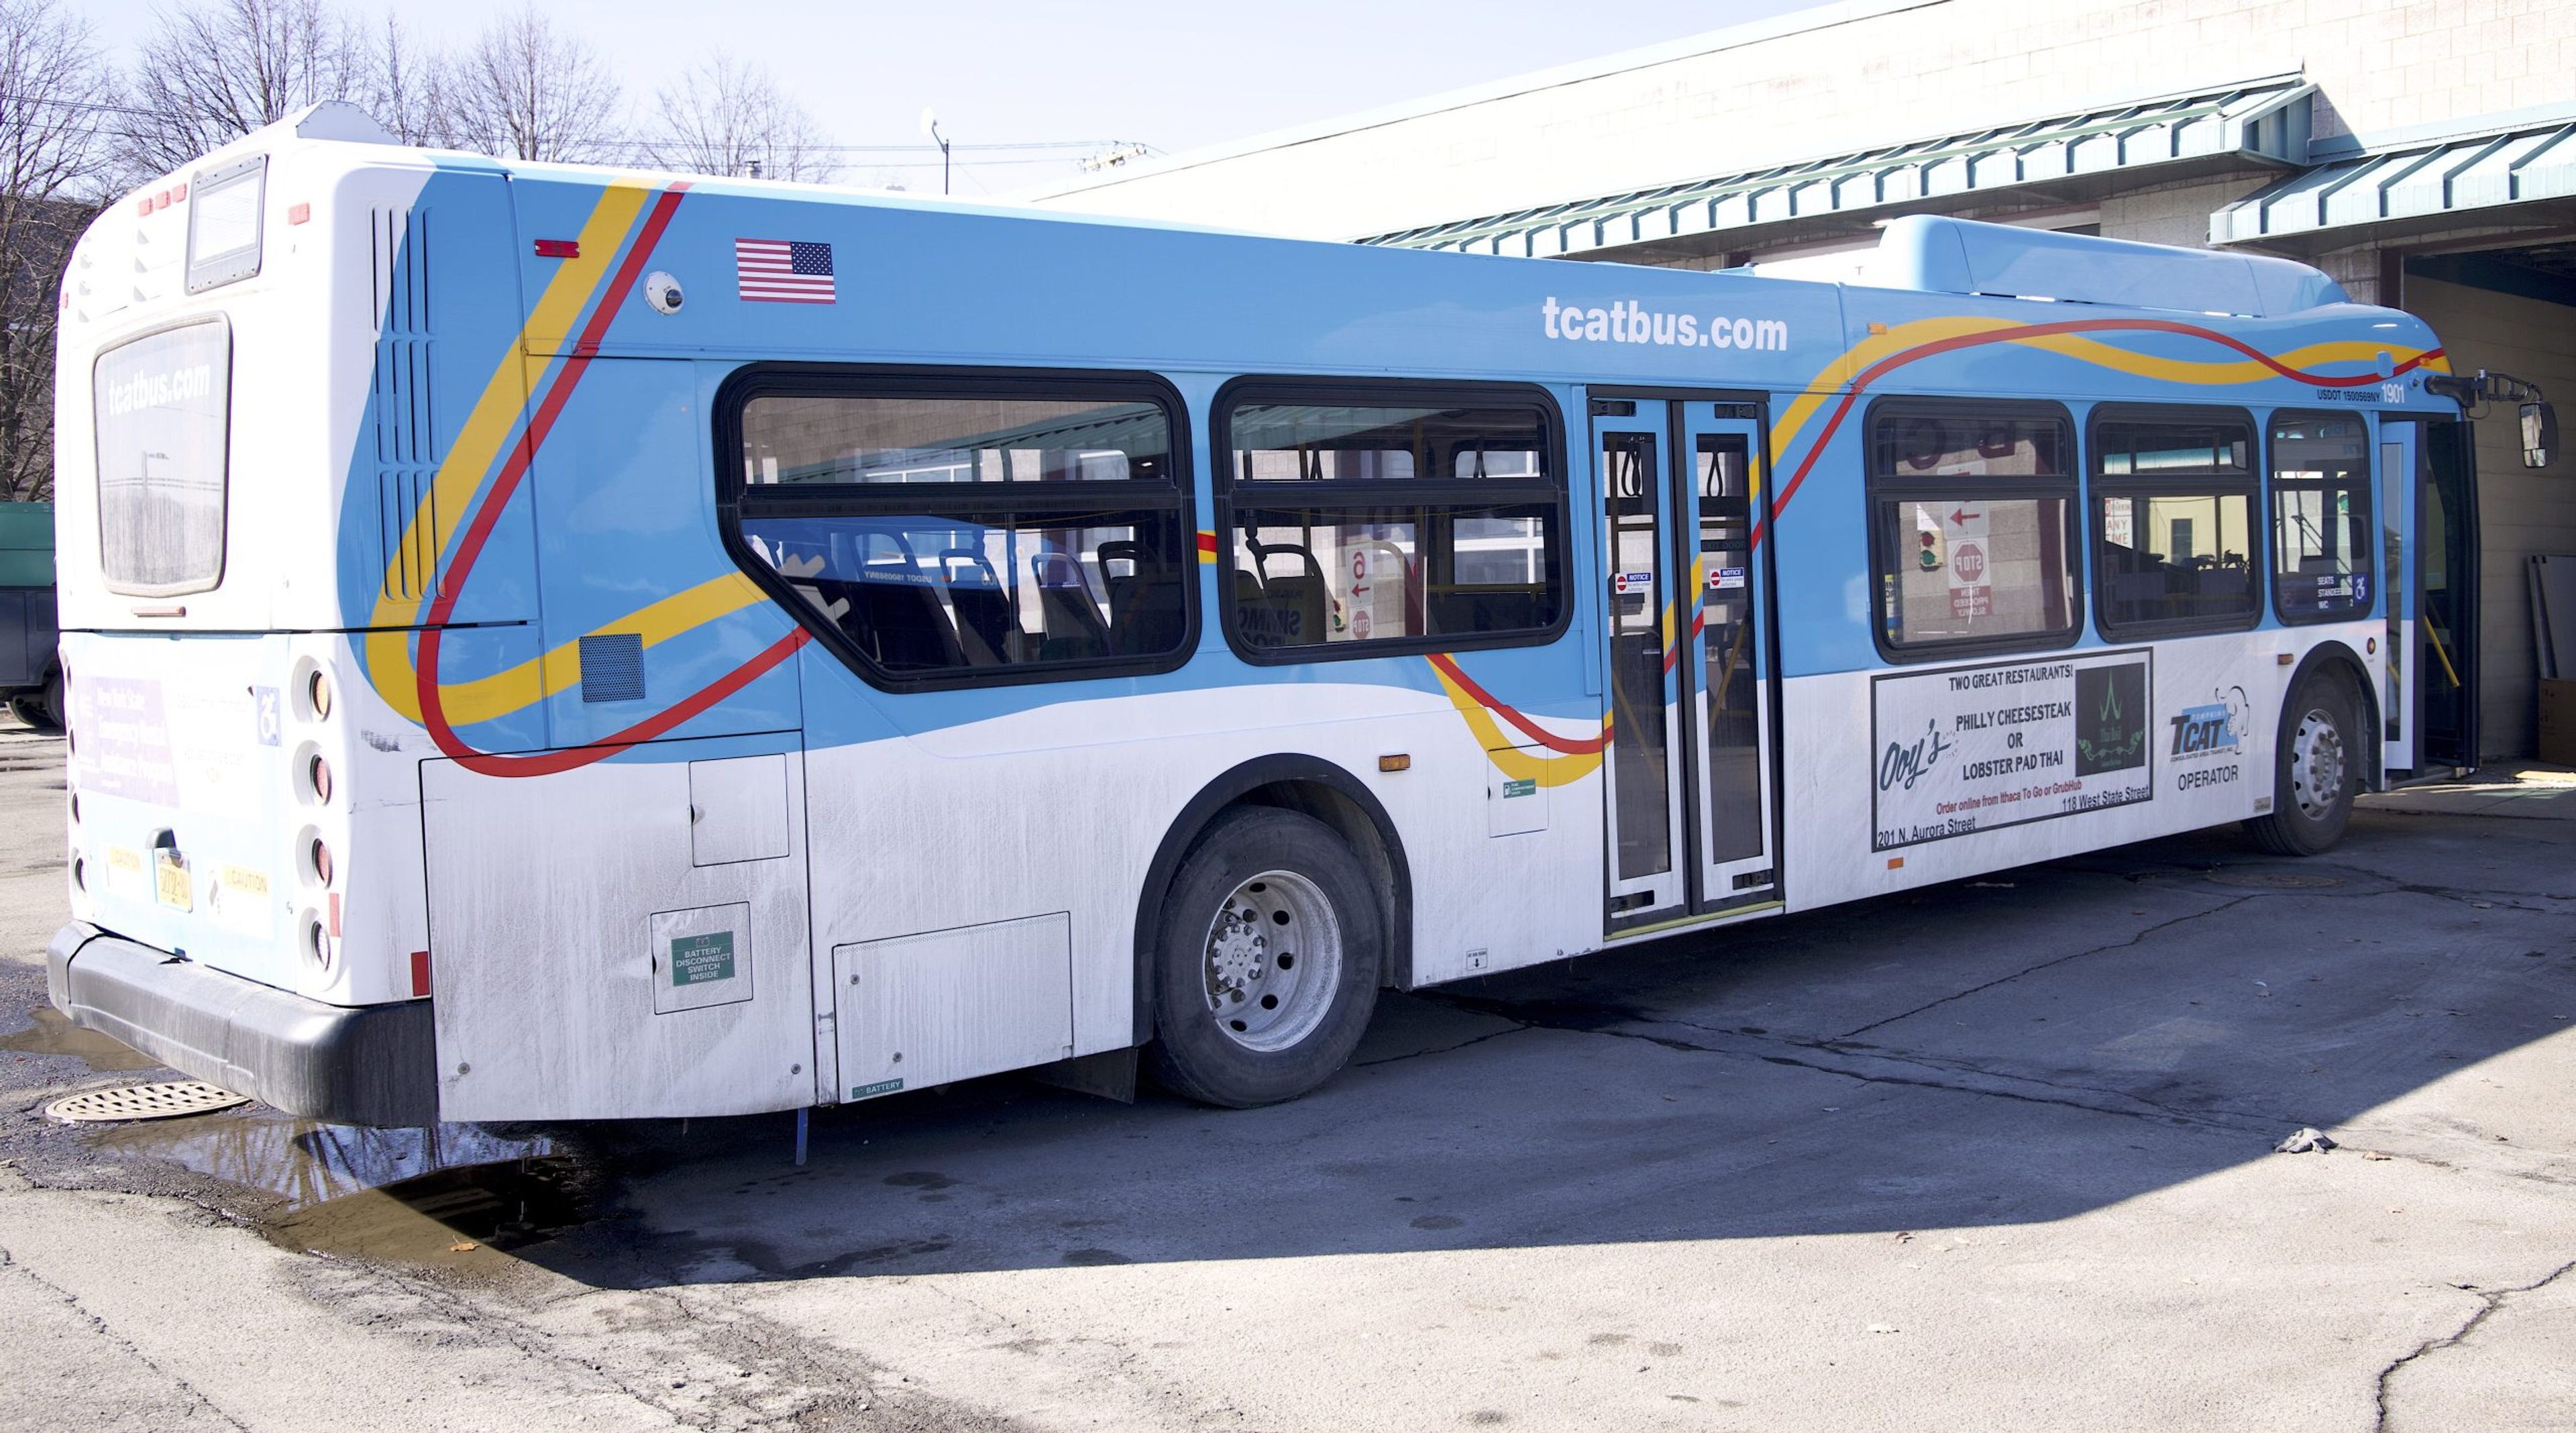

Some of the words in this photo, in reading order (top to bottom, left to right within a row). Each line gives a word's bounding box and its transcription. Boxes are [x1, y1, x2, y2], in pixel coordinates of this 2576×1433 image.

[1542, 297, 1787, 351] tcatbus.com
[109, 364, 210, 415] tcatbus.com
[2317, 389, 2341, 401] USDOT
[2343, 390, 2380, 403] 1500569NY
[2381, 383, 2404, 403] 1901
[2107, 520, 2127, 531] ANY
[2317, 576, 2334, 585] SEATS
[2318, 600, 2328, 609] WC
[1949, 676, 1970, 691] TWO
[1972, 672, 2004, 689] GREAT
[2006, 664, 2073, 684] RESTAURANTS!
[1956, 711, 1995, 731] PHILLY
[1998, 701, 2071, 726] CHEESESTEAK
[2007, 732, 2023, 749] OR
[2170, 714, 2224, 755] TCAT
[1963, 757, 2013, 780] LOBSTER
[2016, 754, 2037, 772] PAD
[2040, 750, 2063, 767] THAI
[2178, 765, 2239, 791] OPERATOR
[1937, 801, 1957, 814] Order
[1959, 798, 1980, 810] online
[1982, 795, 1998, 806] from
[2000, 791, 2021, 804] Ithaca
[2022, 788, 2031, 800] To
[2033, 786, 2043, 798] Go
[2044, 786, 2051, 796] or
[2053, 780, 2082, 795] GrubHub
[2062, 798, 2077, 812] 118
[2078, 793, 2100, 809] West
[2102, 789, 2123, 805] State
[2125, 786, 2149, 801] Street
[1878, 829, 1895, 847] 201
[1899, 827, 1909, 843] N.
[1912, 821, 1945, 840] Aurora
[1947, 815, 1976, 834] Street
[231, 869, 268, 893] CAUTION
[676, 953, 731, 967] DISCONNECT
[685, 947, 721, 959] BATTERY
[688, 962, 720, 973] SWITCH
[690, 970, 719, 981] INSIDE
[866, 1081, 901, 1094] BATTERY
